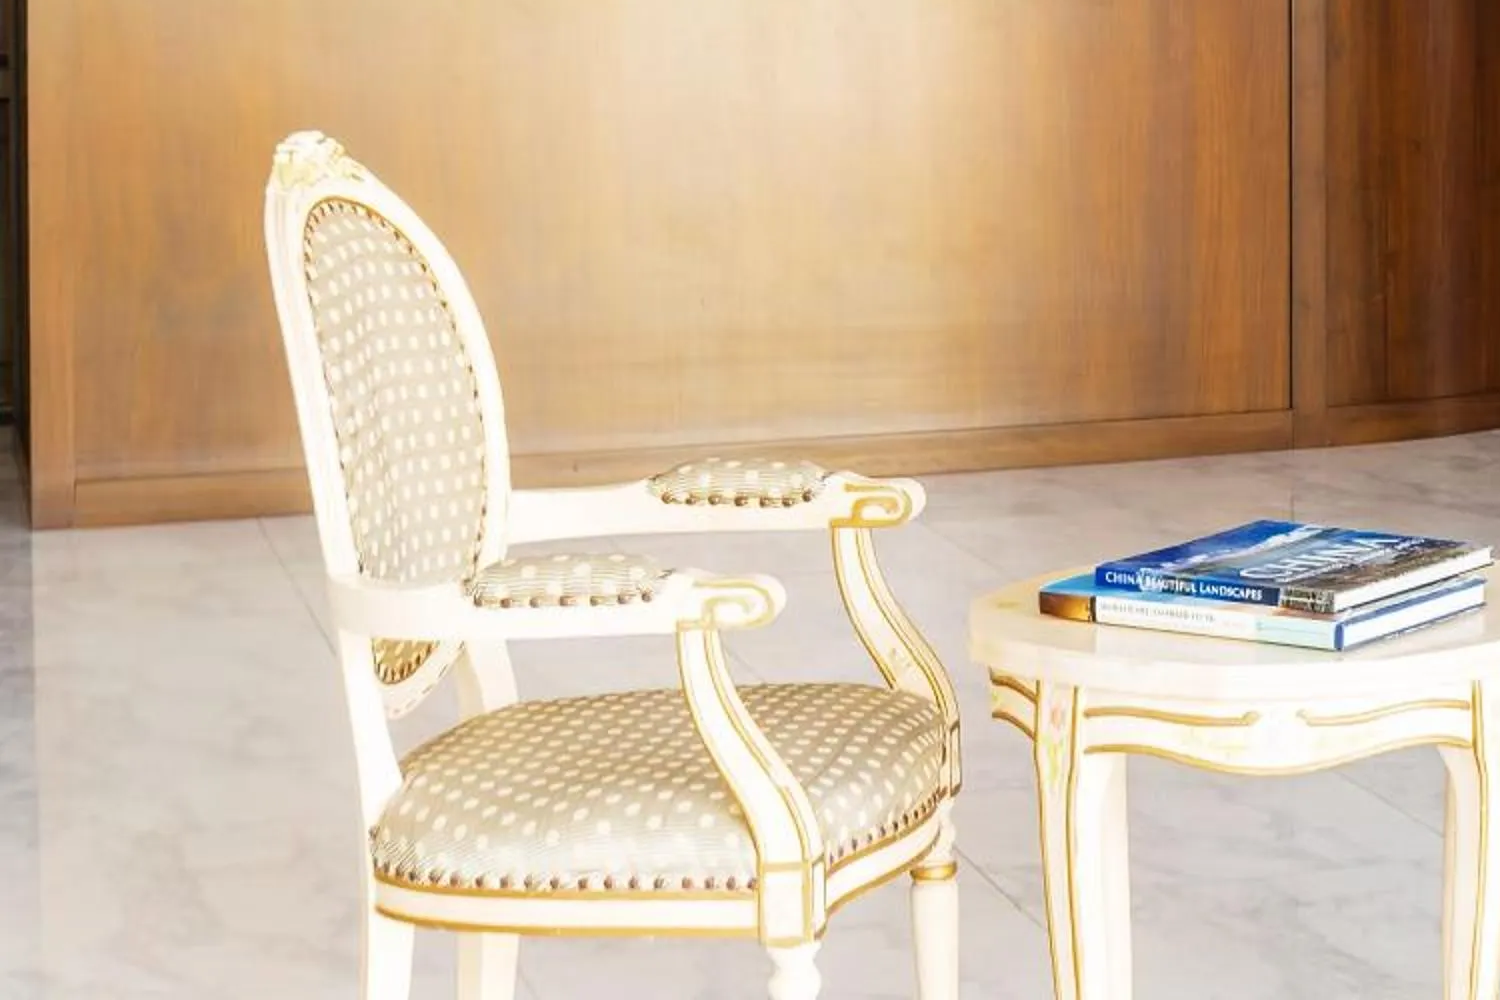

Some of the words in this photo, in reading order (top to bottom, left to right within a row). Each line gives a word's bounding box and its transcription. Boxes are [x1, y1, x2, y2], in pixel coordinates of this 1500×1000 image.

[1239, 538, 1402, 581] CHINA
[1105, 570, 1142, 586] CHINA
[1199, 582, 1263, 601] LANDSCAPES
